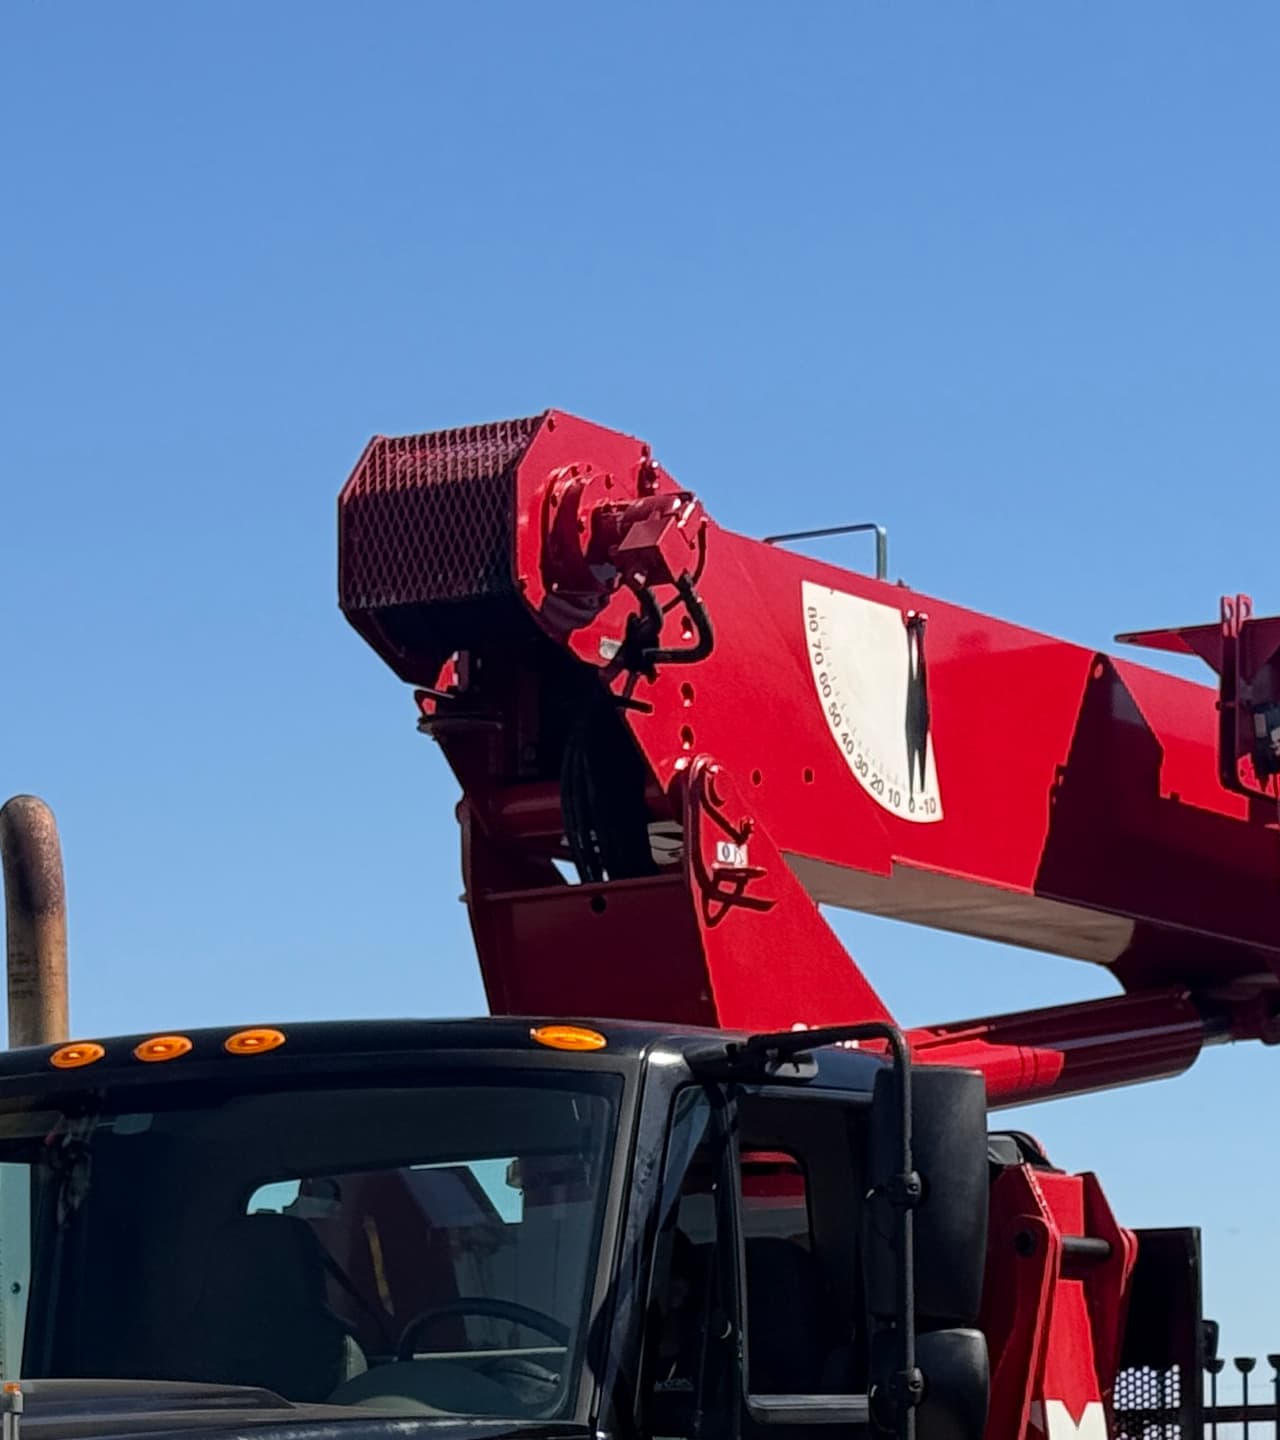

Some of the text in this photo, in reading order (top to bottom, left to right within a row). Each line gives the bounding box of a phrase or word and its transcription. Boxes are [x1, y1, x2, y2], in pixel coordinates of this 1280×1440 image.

[812, 638, 824, 665] 70
[819, 672, 832, 698] 60
[828, 702, 842, 727] 50
[841, 733, 854, 755] 40
[854, 754, 869, 778] 30
[870, 773, 885, 796] 20
[888, 787, 901, 808] 10
[918, 797, 937, 815] -10
